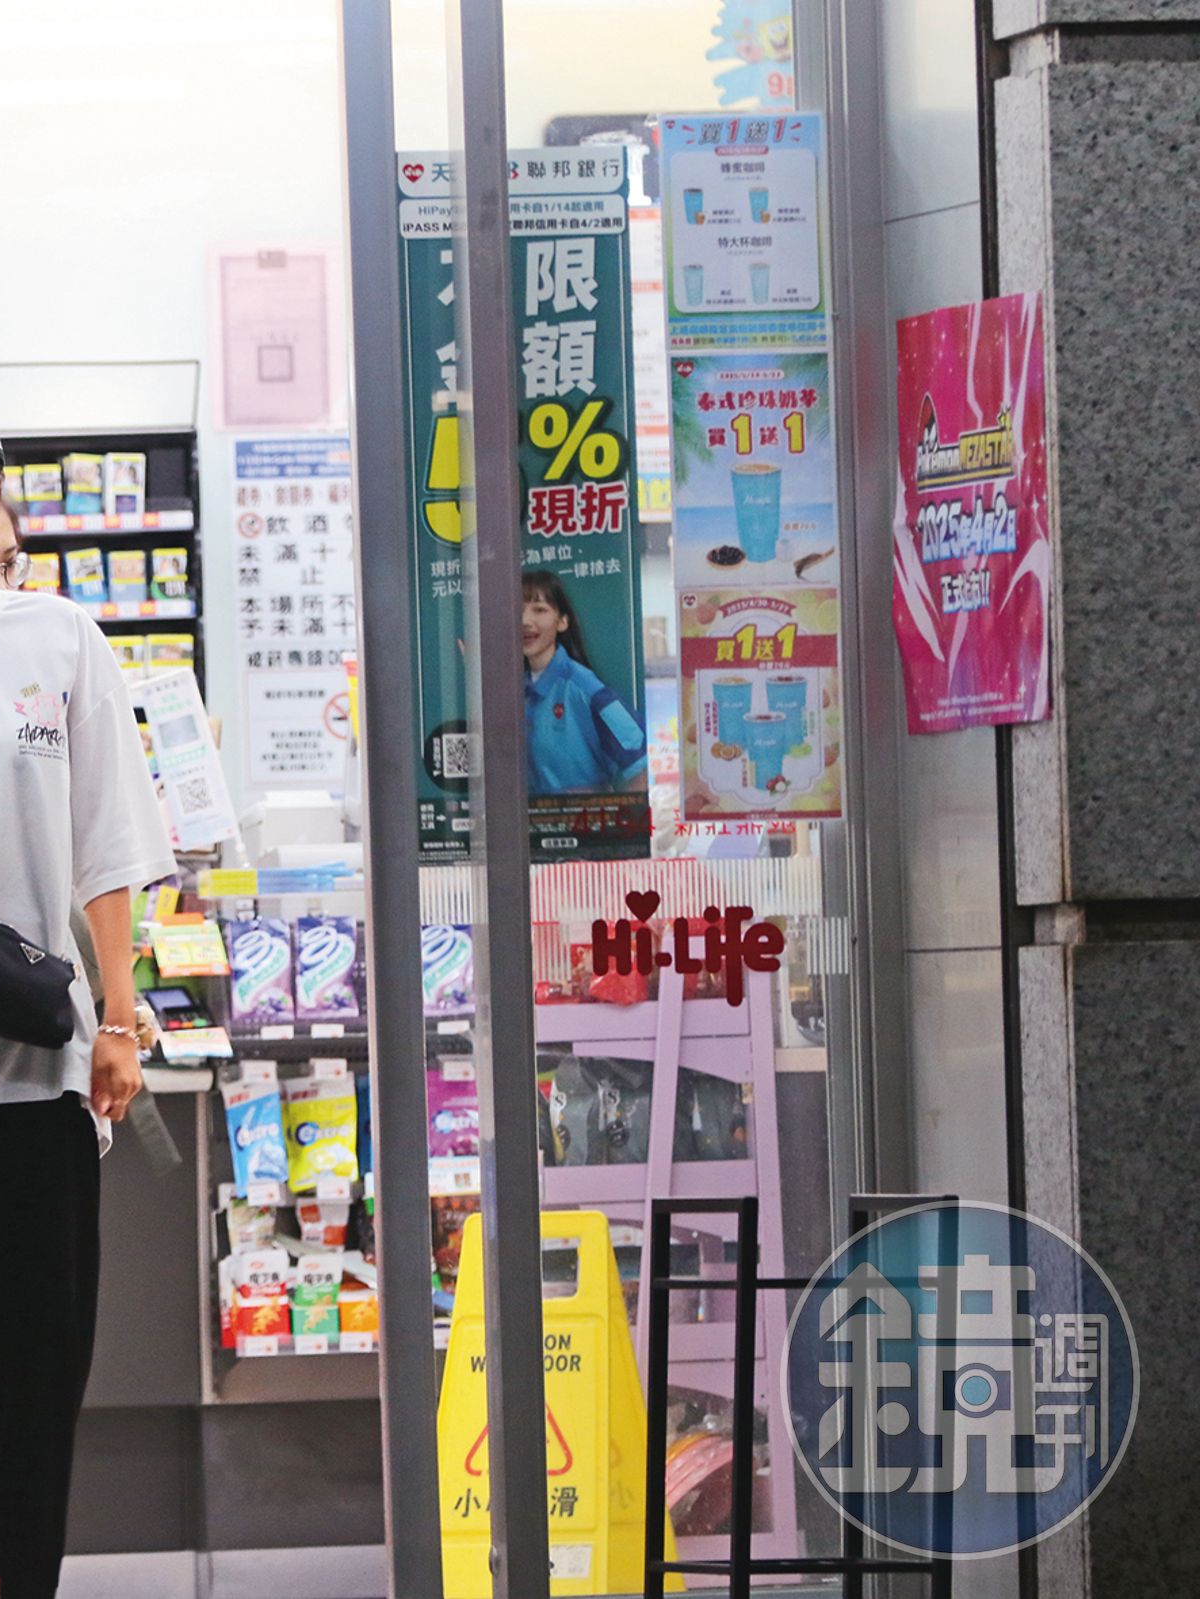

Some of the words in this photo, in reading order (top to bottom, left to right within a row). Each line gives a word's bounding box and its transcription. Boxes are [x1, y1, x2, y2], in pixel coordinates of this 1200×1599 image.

[527, 158, 620, 179] 聯邦銀行
[698, 388, 818, 412] 泰式珍珠奶茶
[527, 481, 630, 538] 現折
[239, 543, 353, 563] 未滿十
[715, 623, 798, 663] 買1送1
[544, 1334, 571, 1351] ON
[544, 1354, 581, 1372] OOR
